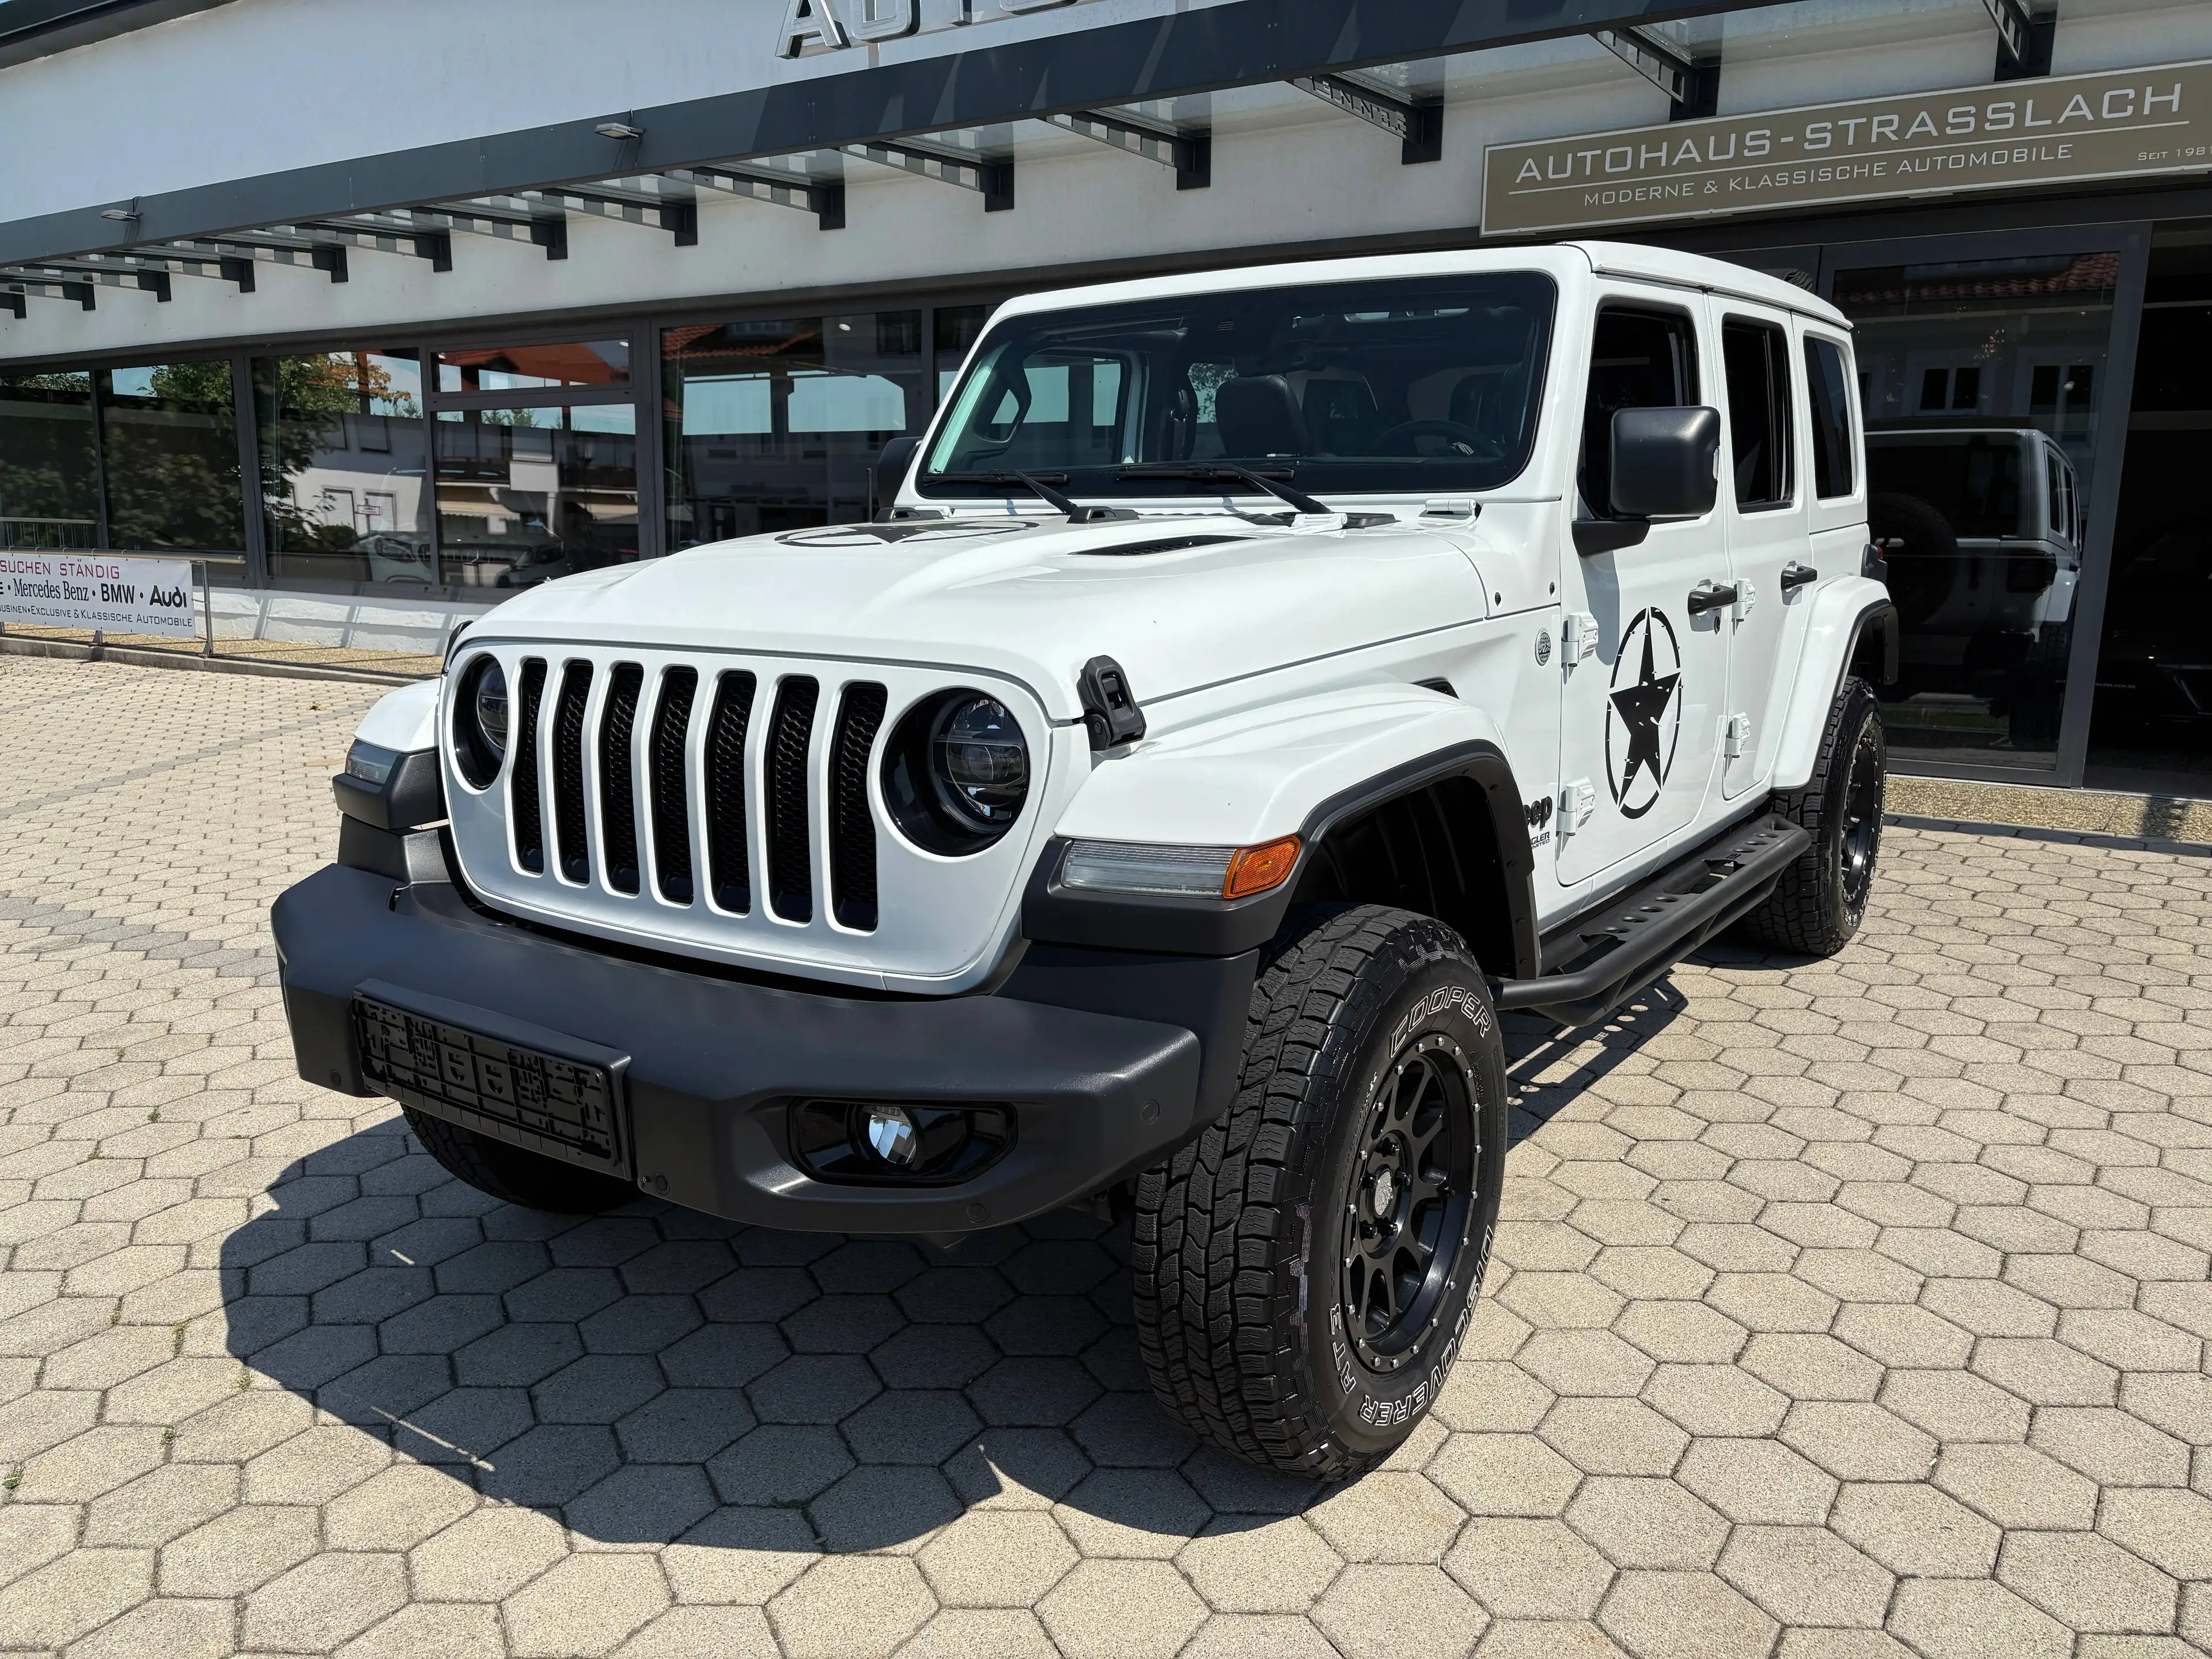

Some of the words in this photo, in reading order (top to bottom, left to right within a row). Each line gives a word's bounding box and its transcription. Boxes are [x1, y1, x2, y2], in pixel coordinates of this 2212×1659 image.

[1515, 82, 2181, 183] AUTOHAUS-STRASSLACH
[2138, 151, 2169, 160] SEIT
[1584, 182, 1695, 206] MODERNE
[1703, 180, 1718, 194] &
[1729, 161, 1887, 191] KLASSISCHE
[1896, 143, 2073, 174] AUTOMOBILE
[0, 560, 51, 575] SUCHEN
[59, 558, 120, 579] STÄNDIG
[0, 604, 26, 613] USINEN
[136, 613, 192, 627] AUTOMOBILE
[13, 578, 60, 599] Mercedes
[62, 581, 89, 601] Benz
[101, 583, 135, 604] BMW
[149, 585, 187, 608] Audi
[1389, 986, 1492, 1058] COOPER
[1359, 1224, 1494, 1426] DISCOVERER
